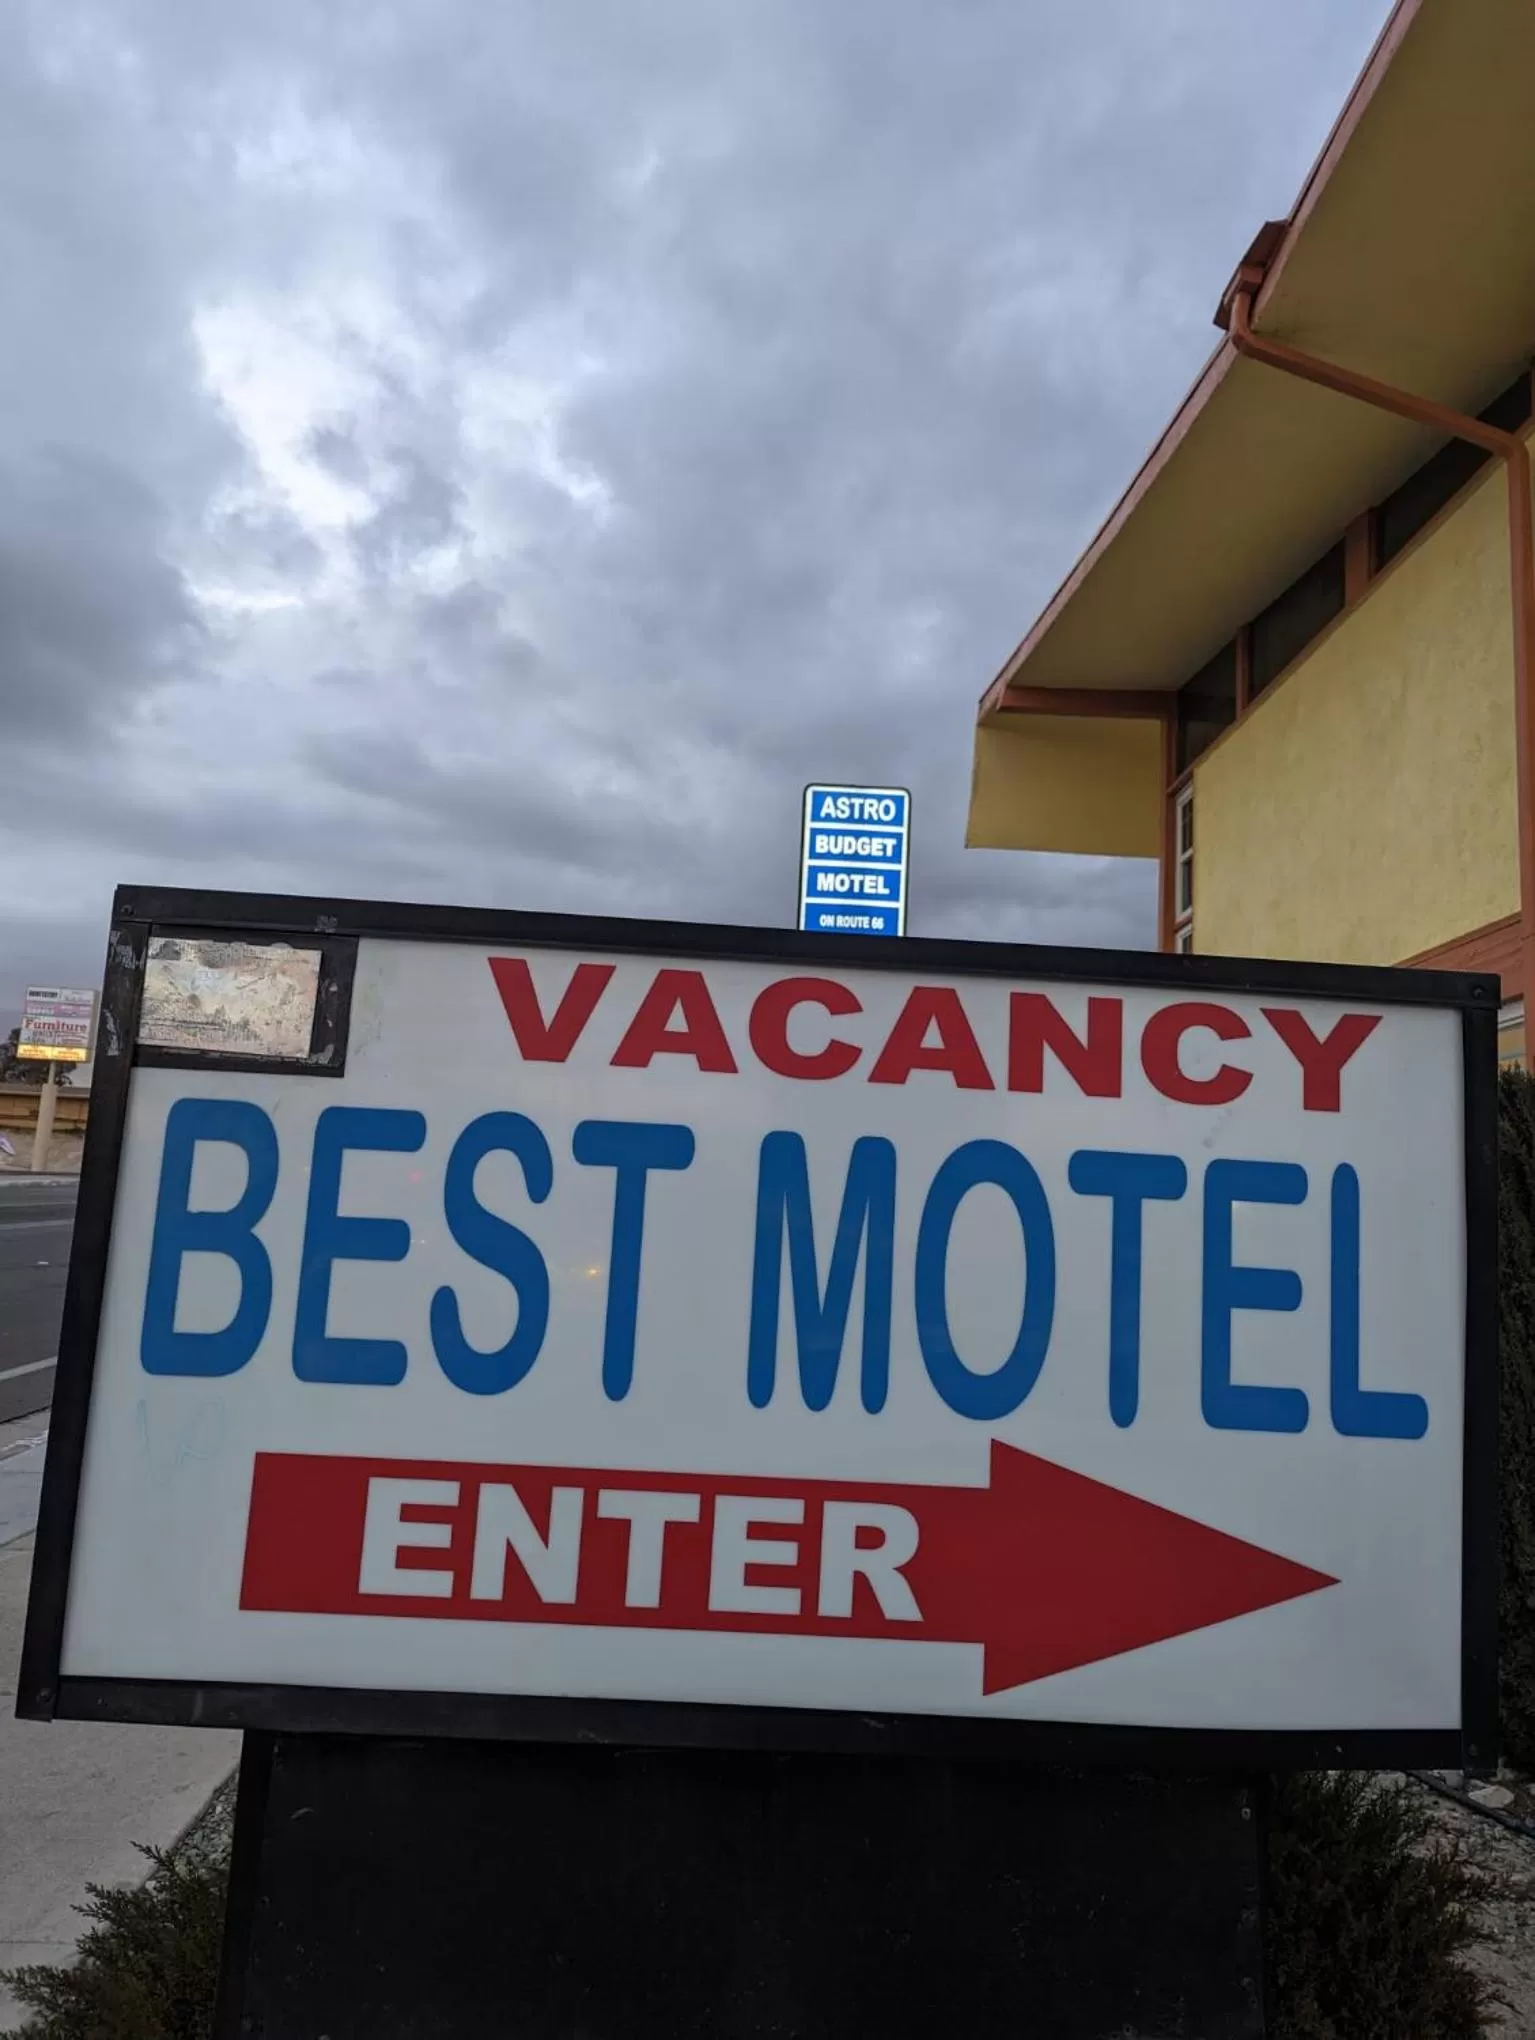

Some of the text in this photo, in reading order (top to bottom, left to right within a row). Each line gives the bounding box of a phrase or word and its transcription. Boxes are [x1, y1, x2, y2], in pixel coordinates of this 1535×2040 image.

[820, 796, 895, 821] ASTRO
[815, 835, 896, 857] BUDGET
[816, 873, 890, 895] MOTEL
[819, 914, 885, 930] ON ROUTE 66
[25, 1019, 87, 1031] Furniture
[489, 957, 1382, 1111] VACANCY
[140, 1098, 1430, 1440] BEST MOTEL
[358, 1477, 922, 1623] ENTER
